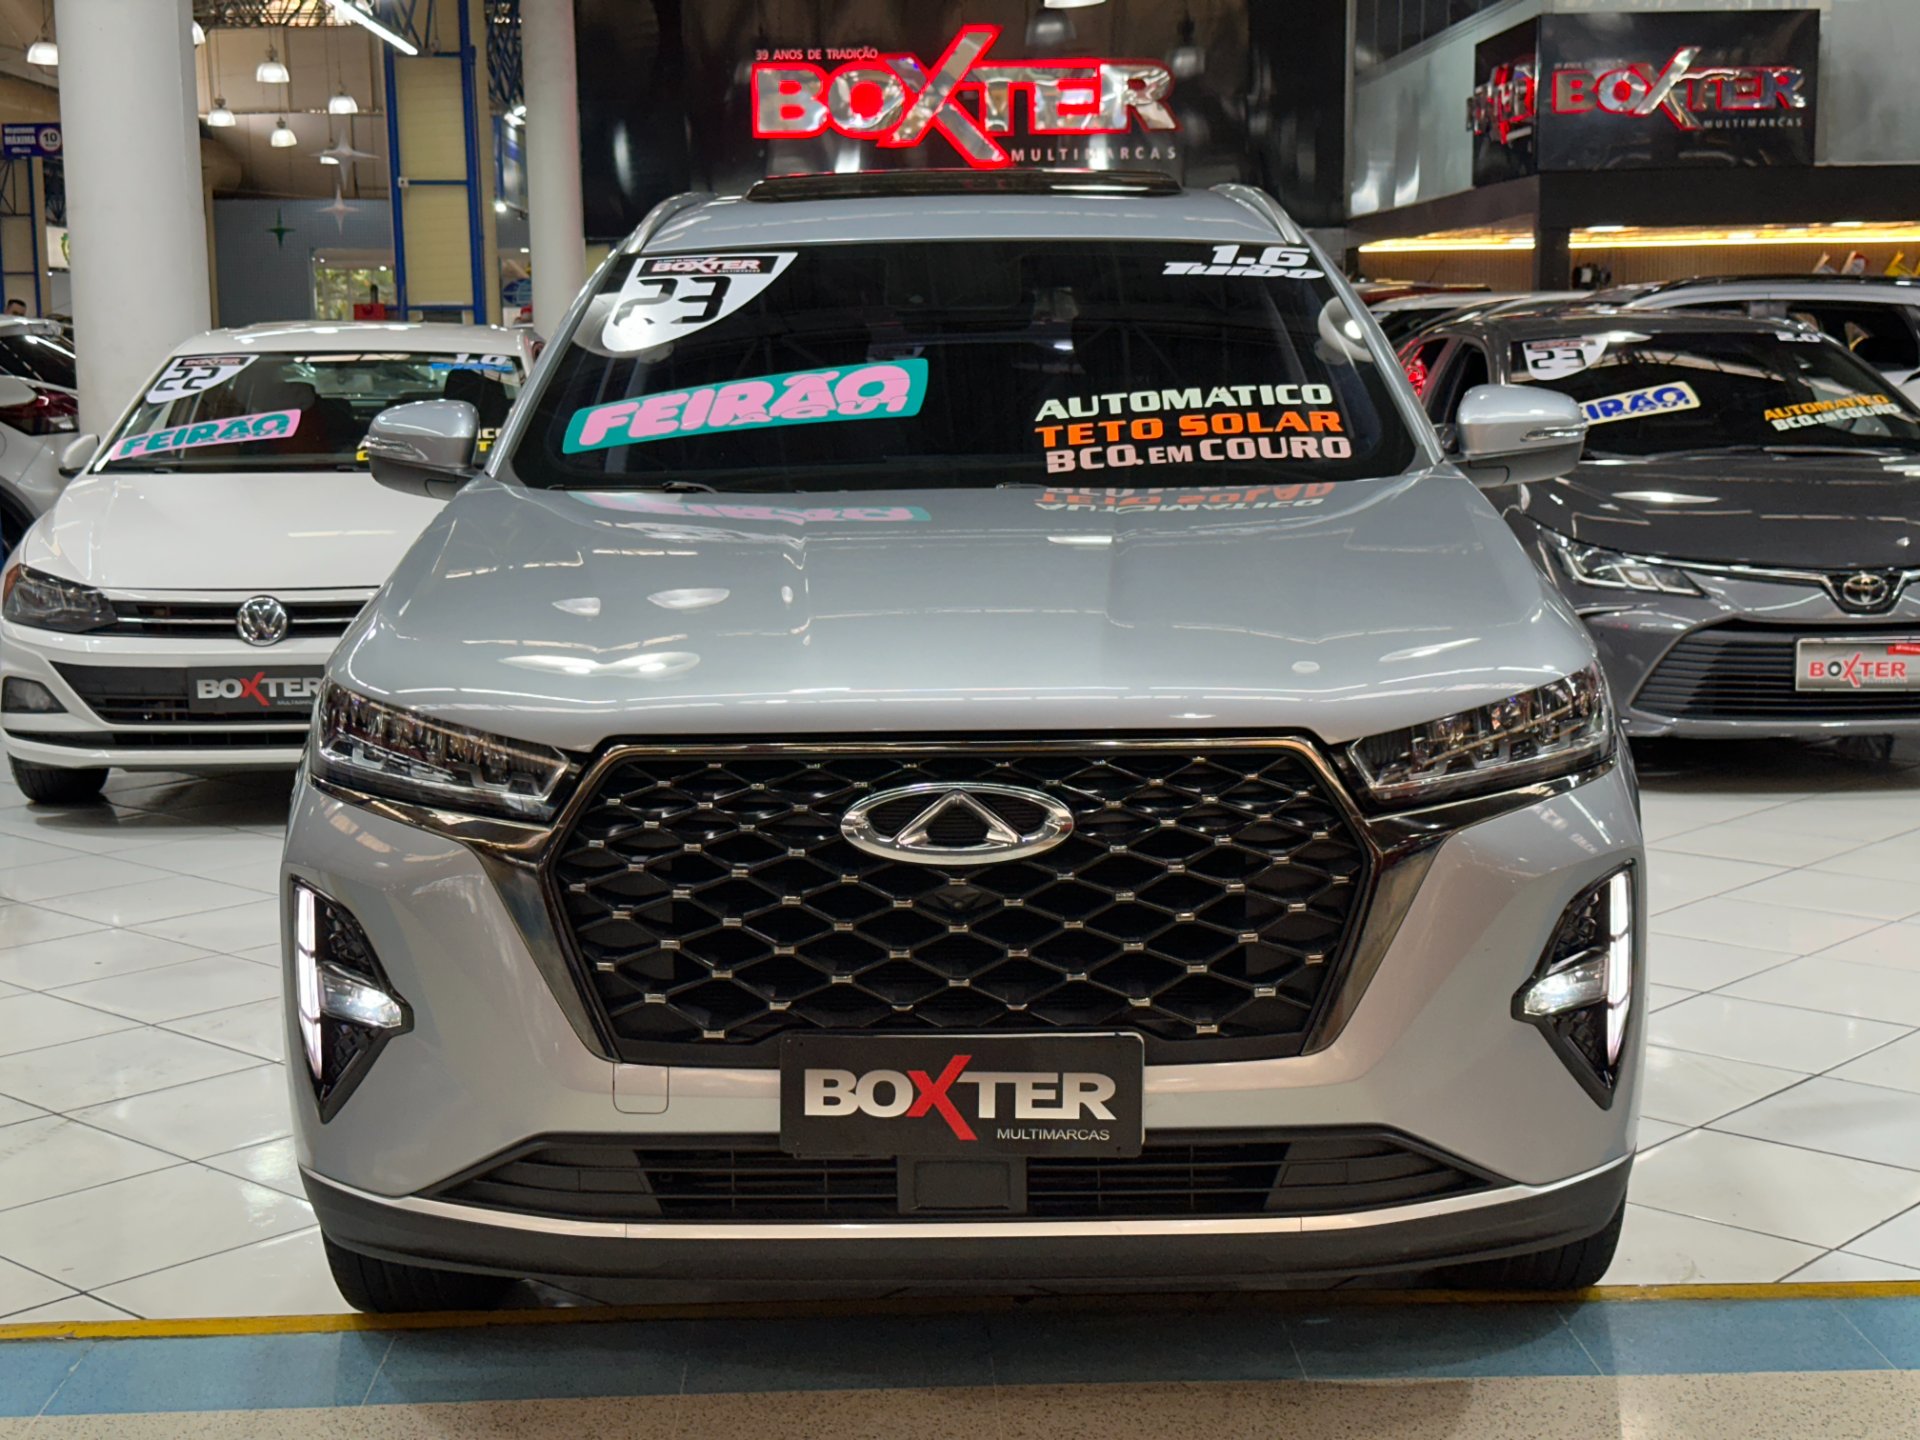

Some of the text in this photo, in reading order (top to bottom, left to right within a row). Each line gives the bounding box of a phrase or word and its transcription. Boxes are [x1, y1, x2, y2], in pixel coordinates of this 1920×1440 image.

[773, 49, 804, 60] ANOS
[807, 49, 822, 60] DE
[826, 45, 879, 60] TRADIÇÃO
[752, 24, 1178, 166] BOXTER
[1552, 46, 1806, 131] BOXTER
[43, 132, 58, 143] 10
[1703, 117, 1803, 129] MULTIMARCAS
[1011, 146, 1177, 162] MULTIMARCAS
[651, 256, 761, 274] BOXTER
[1212, 244, 1311, 267] 1.6
[613, 275, 732, 327] 23
[1531, 348, 1587, 370] 23
[154, 366, 222, 392] 22
[578, 365, 911, 447] FEIRÃO
[118, 412, 291, 457] FEIRÃO
[1034, 411, 1344, 448] TETO SOLAR
[1148, 445, 1194, 465] EM
[1198, 436, 1353, 461] COURO
[1808, 651, 1907, 688] BOXTER
[197, 671, 323, 707] BOXTER
[803, 1055, 1117, 1141] BOXTER
[996, 1127, 1111, 1142] MULTIMARCAS
